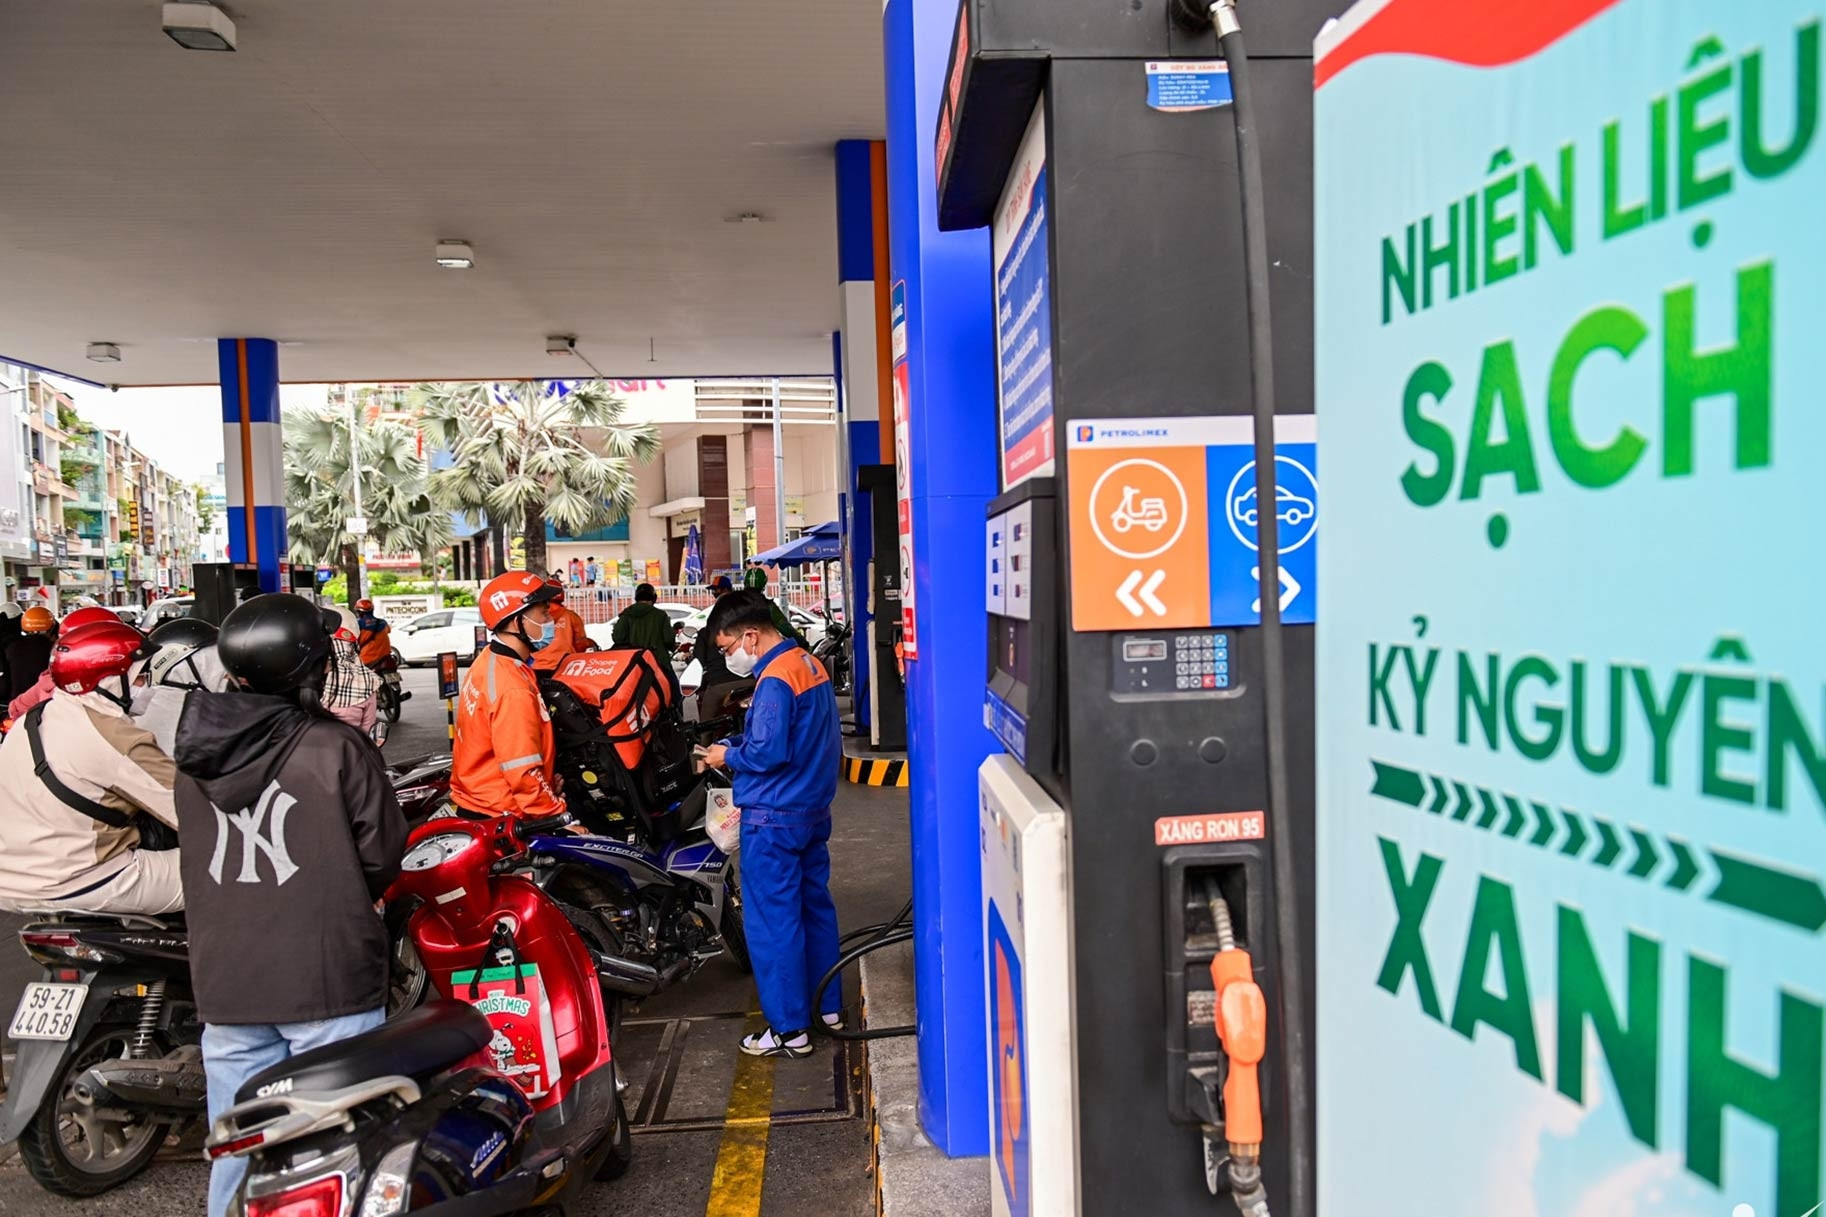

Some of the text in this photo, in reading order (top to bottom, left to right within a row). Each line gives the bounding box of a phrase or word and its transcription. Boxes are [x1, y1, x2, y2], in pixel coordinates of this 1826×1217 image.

[1382, 15, 1822, 325] NHIÊN LIỆU
[1400, 257, 1775, 549] SẠCH
[1100, 429, 1168, 437] PETROLIMEX
[582, 666, 614, 676] Food
[588, 658, 618, 667] Shopee
[1368, 615, 1826, 825] KỶ NGUYÊN
[1206, 819, 1239, 840] RON
[1241, 817, 1260, 837] 95
[583, 843, 630, 854] EXCITER
[30, 987, 76, 1010] 59-Z1
[15, 1011, 73, 1035] 440.58
[1376, 833, 1824, 1217] XANH
[256, 1077, 293, 1098] SYM
